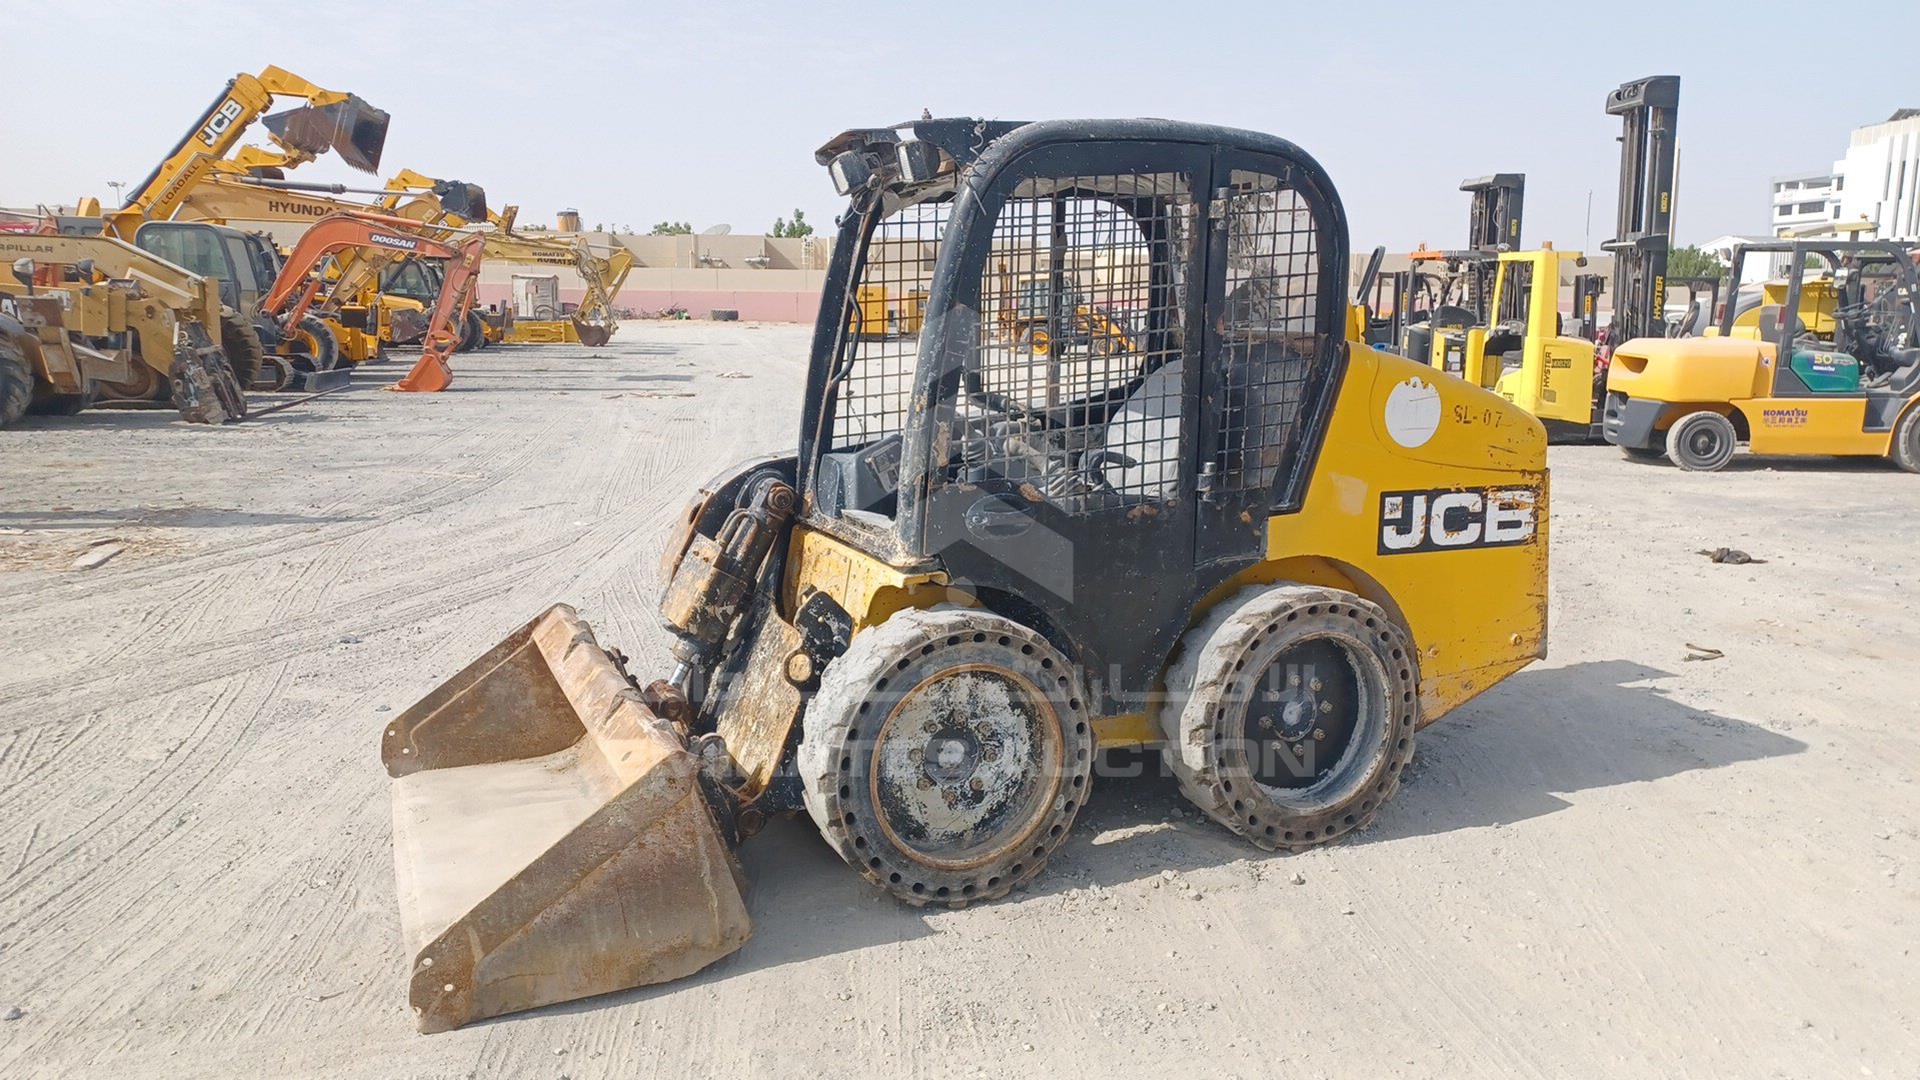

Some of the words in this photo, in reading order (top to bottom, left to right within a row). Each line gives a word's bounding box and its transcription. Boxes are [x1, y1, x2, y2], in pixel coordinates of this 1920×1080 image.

[197, 99, 242, 146] JCB
[161, 164, 200, 205] LOADALL
[269, 201, 340, 217] HYUNDA
[371, 234, 416, 249] DOOSAN
[1653, 275, 1663, 320] HYSTER
[1543, 351, 1552, 388] HYSTER
[1763, 407, 1808, 417] KOMATSU
[1382, 490, 1536, 550] JCB
